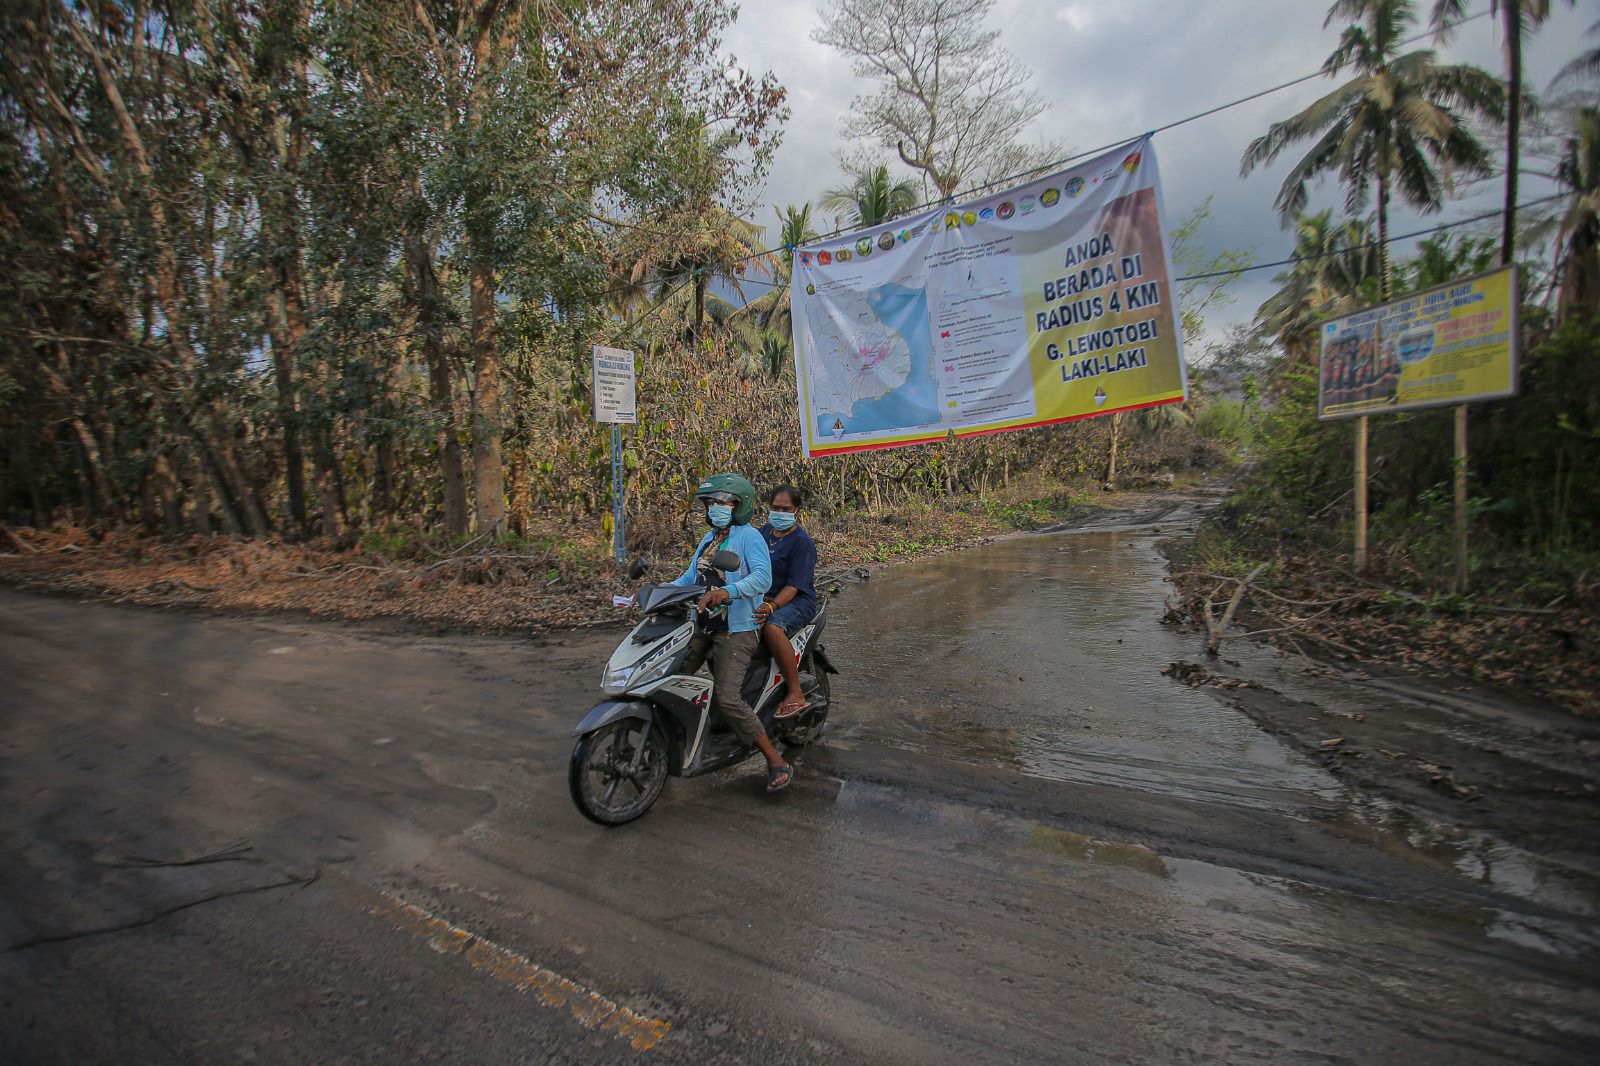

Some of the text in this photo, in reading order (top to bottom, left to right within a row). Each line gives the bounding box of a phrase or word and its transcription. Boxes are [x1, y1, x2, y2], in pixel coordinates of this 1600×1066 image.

[1065, 233, 1115, 268] ANDA
[1043, 262, 1117, 302] BERADA
[1121, 254, 1143, 280] DI
[1036, 296, 1104, 332] RADIUS
[1109, 291, 1121, 313] 4
[1126, 282, 1160, 310] KM
[1047, 320, 1158, 361] G. LEWOTOBI
[1061, 347, 1147, 383] LAKI-LAKI
[671, 681, 707, 691] 125
